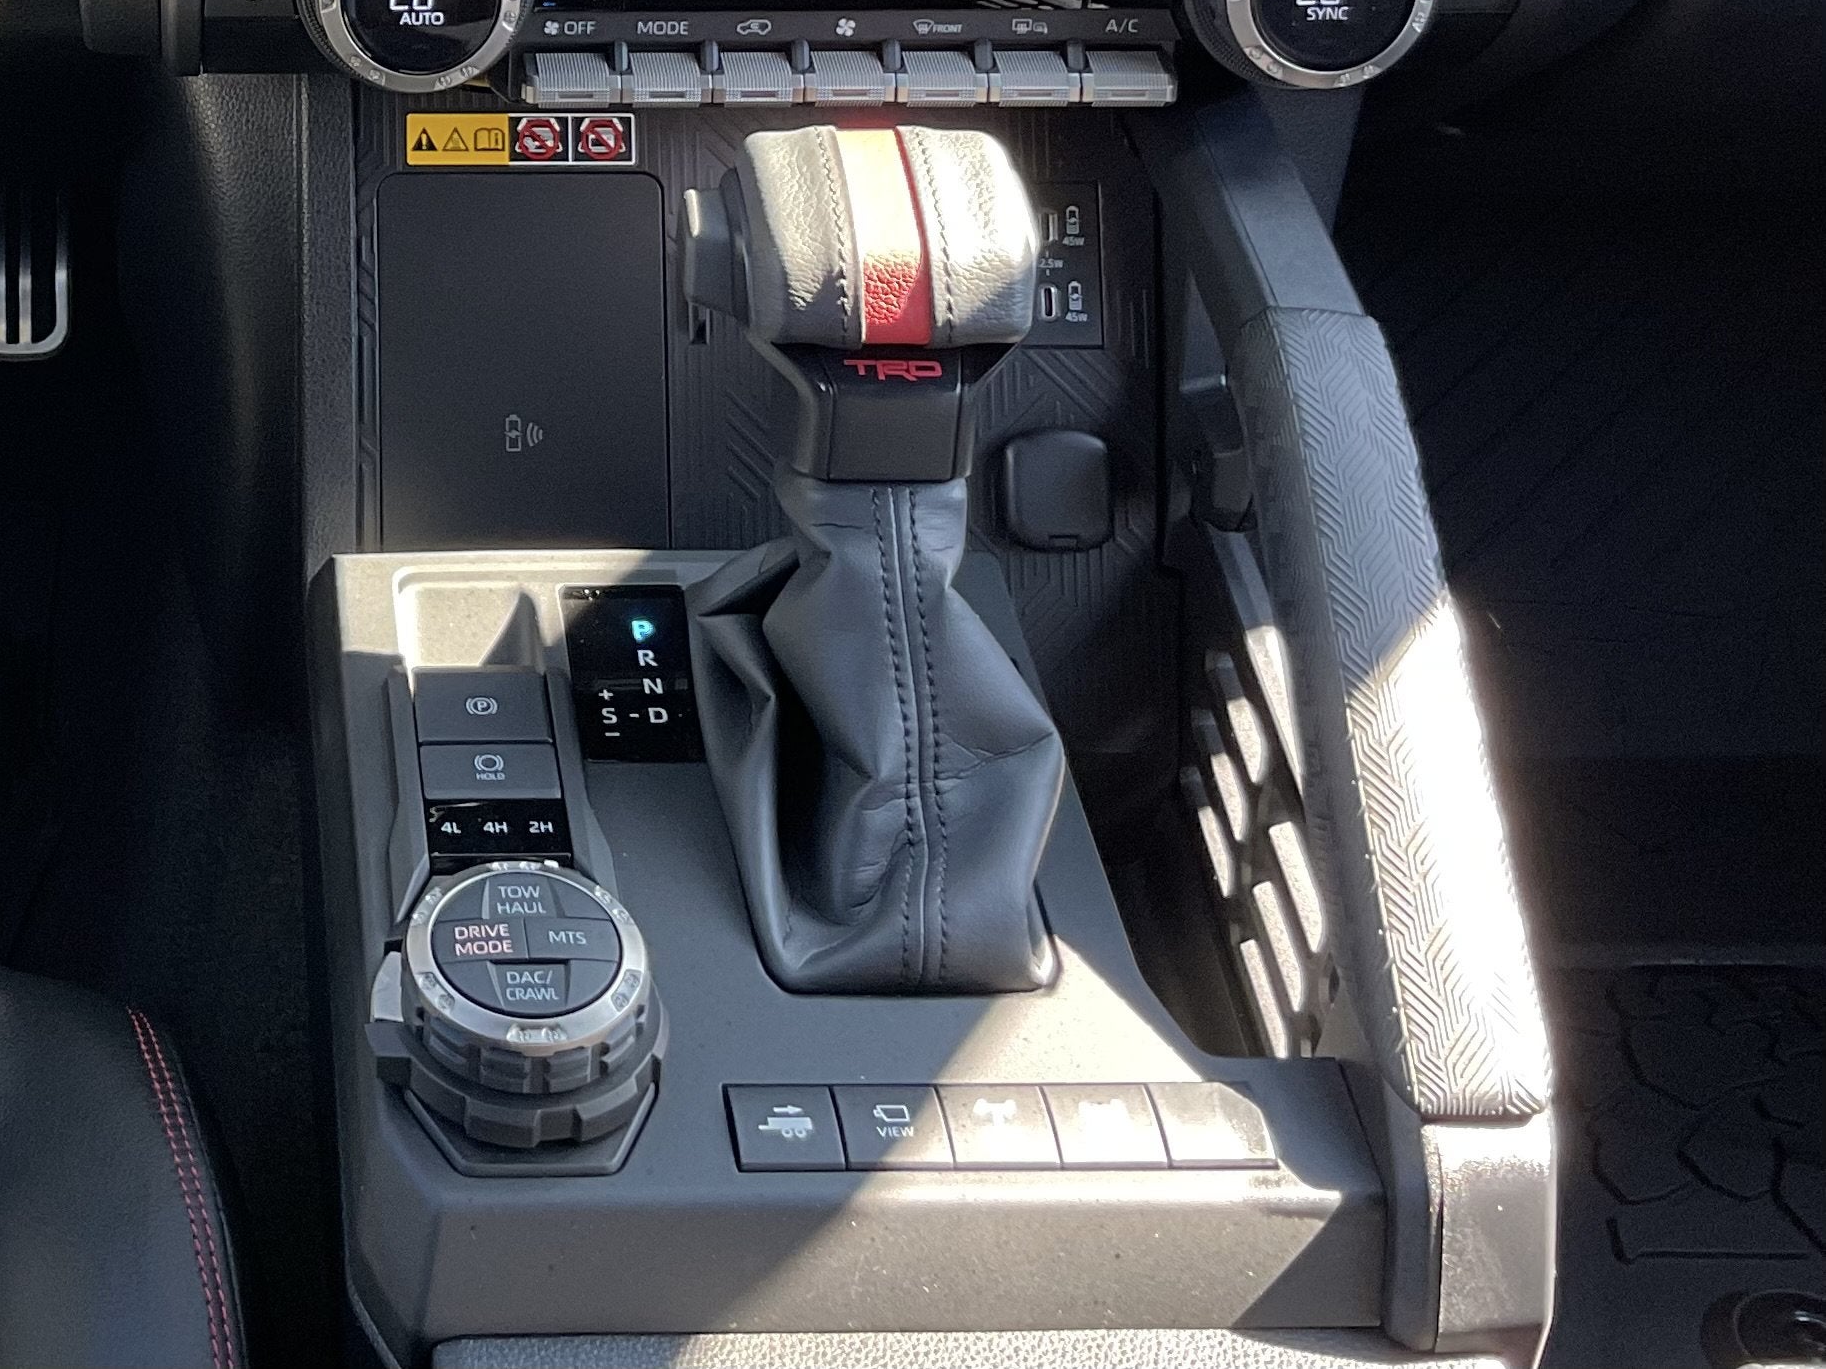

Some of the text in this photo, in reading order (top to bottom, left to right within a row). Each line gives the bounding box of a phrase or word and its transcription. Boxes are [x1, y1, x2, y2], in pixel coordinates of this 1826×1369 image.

[399, 11, 445, 27] AUTO
[1306, 5, 1350, 21] SYNC
[563, 21, 596, 35] OFF
[636, 20, 689, 36] MODE
[932, 23, 963, 34] FRONT
[1105, 18, 1139, 34] A/C
[843, 359, 943, 382] TRD
[631, 619, 656, 641] P
[637, 649, 658, 667] R
[642, 678, 664, 695] N
[602, 707, 669, 724] S D
[476, 772, 505, 780] HOLD
[441, 821, 554, 834] 4L 4H 2H
[498, 885, 541, 899] TOW
[496, 901, 547, 915] HAUL
[454, 923, 511, 939] DRIVE
[548, 930, 587, 945] MTS
[454, 939, 514, 956] MODE
[505, 970, 554, 985] DAC/
[505, 986, 559, 1001] CRAWL
[876, 1125, 915, 1138] VIEW
